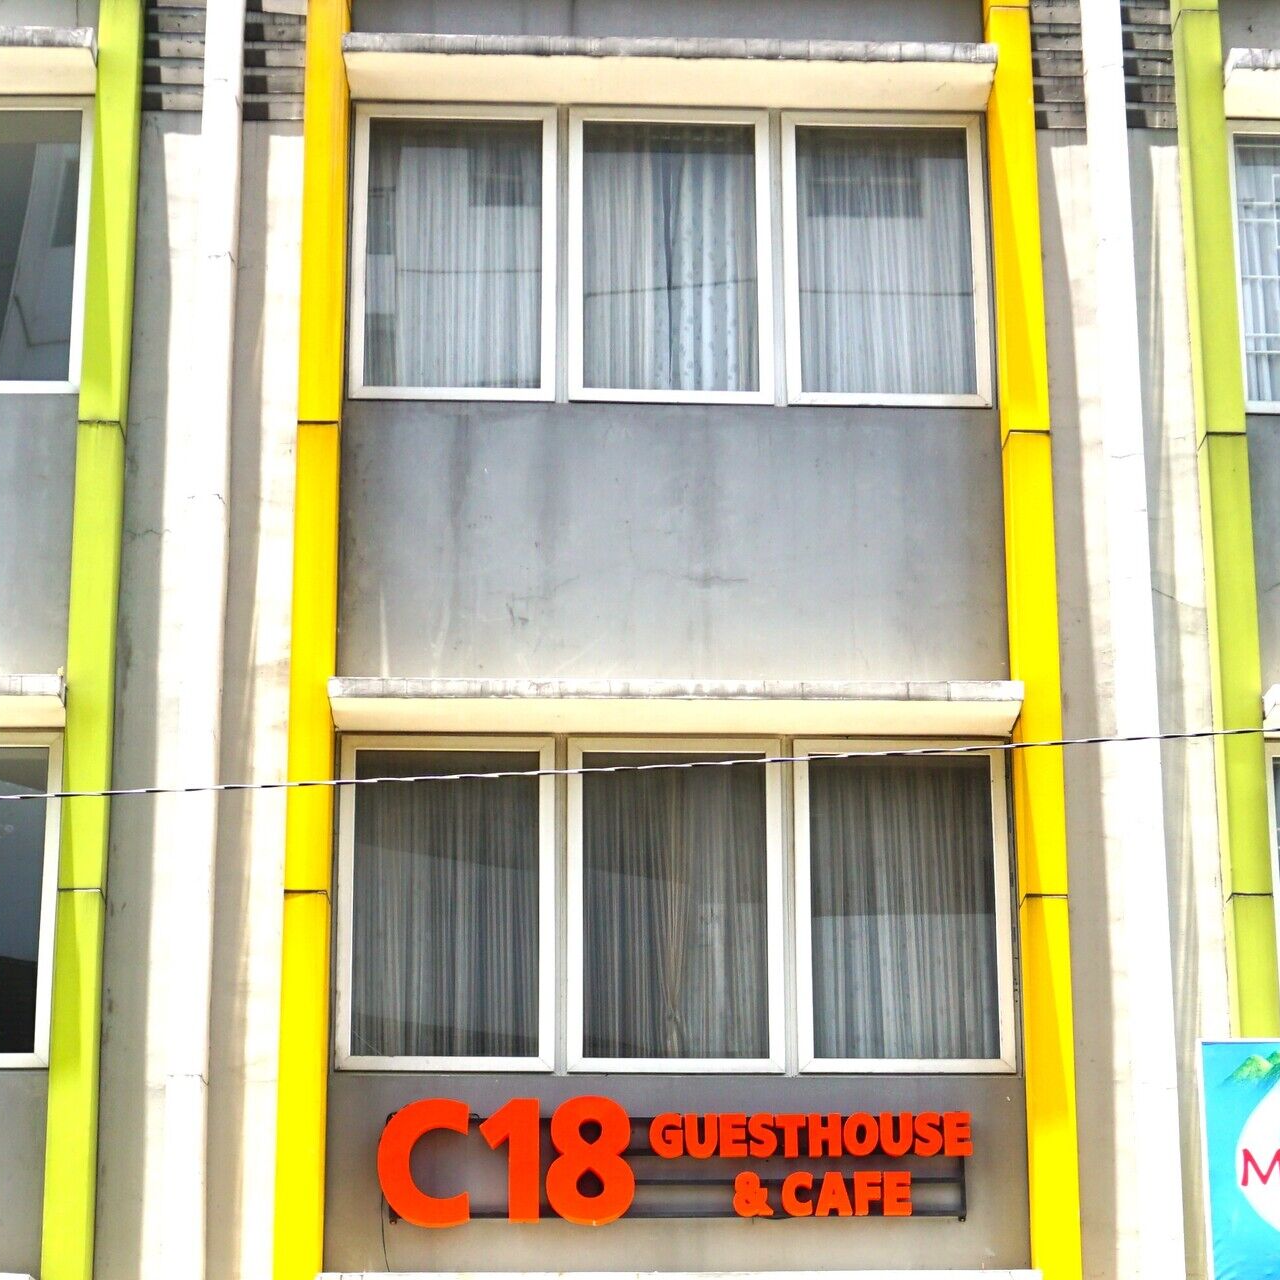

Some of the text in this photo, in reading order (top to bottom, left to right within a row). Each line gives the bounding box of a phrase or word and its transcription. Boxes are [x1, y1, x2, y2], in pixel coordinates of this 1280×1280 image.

[377, 1095, 974, 1228] C18 GUESTHOUSE
[733, 1170, 913, 1218] & CAFE
